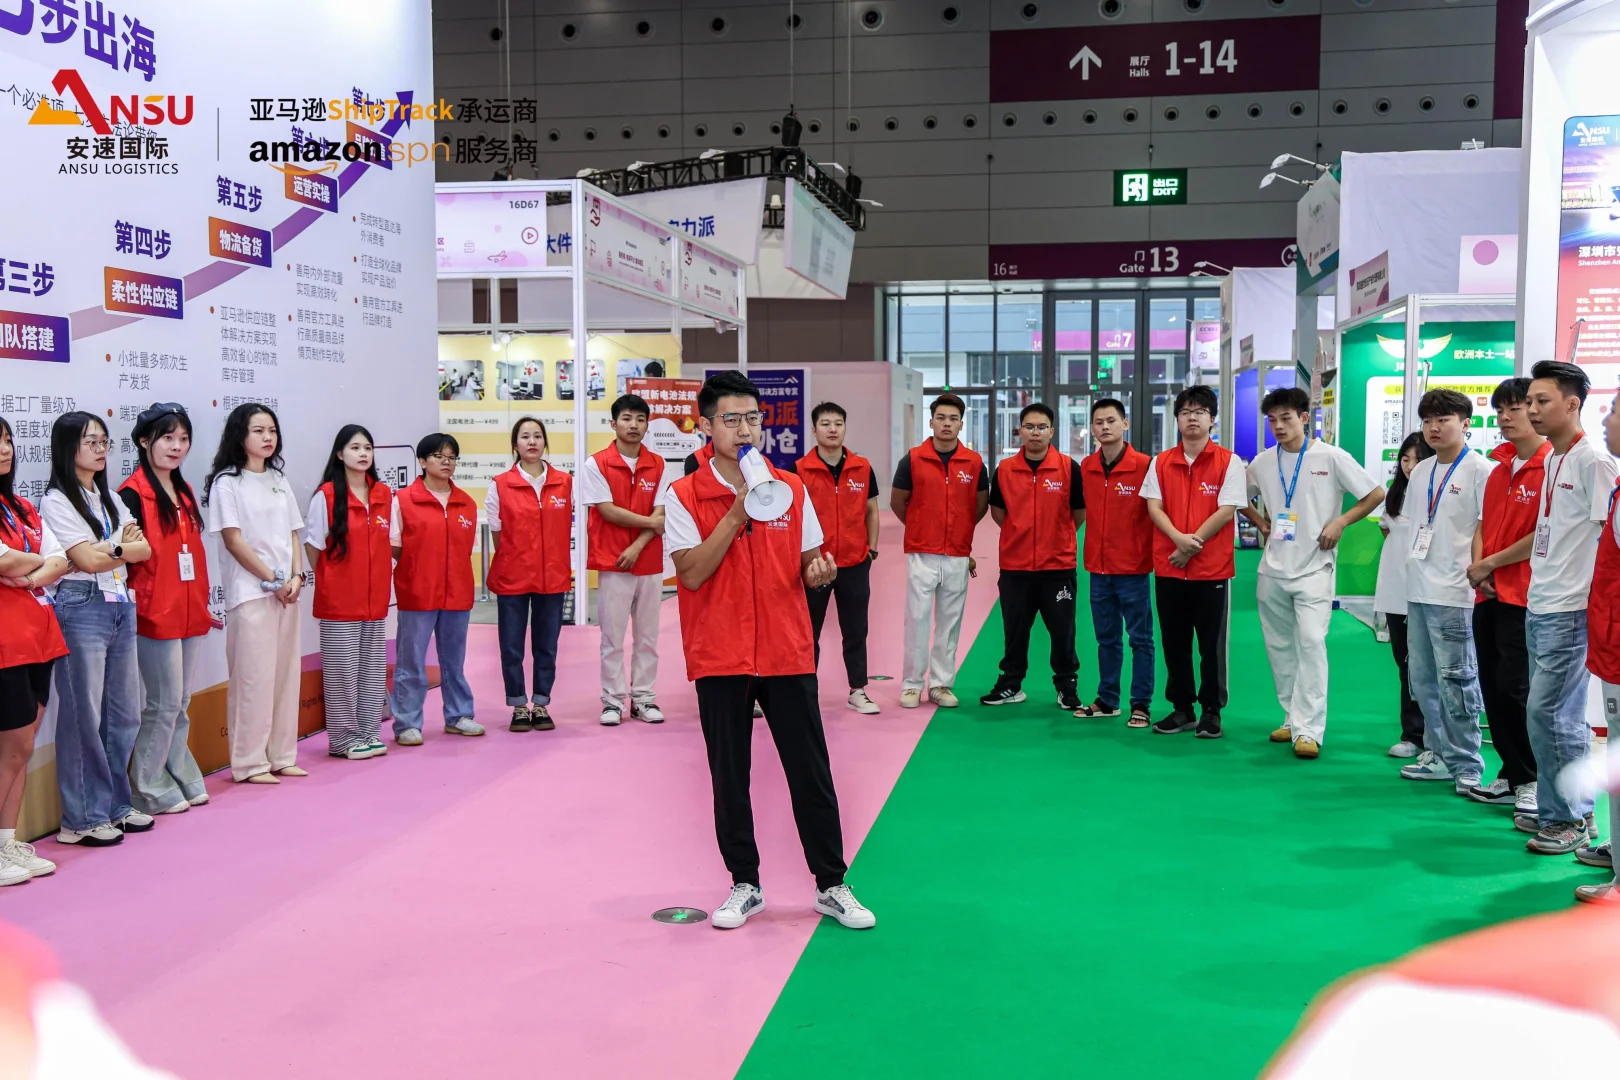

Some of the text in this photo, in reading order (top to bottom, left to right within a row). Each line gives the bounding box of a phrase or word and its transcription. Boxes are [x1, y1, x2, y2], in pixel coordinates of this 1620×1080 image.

[1165, 39, 1238, 75] 1-14
[1129, 67, 1150, 77] Halls
[216, 174, 263, 213] 第五步
[1152, 178, 1178, 187] 出口
[1152, 187, 1178, 196] EXIT
[509, 200, 540, 209] 16D67
[667, 215, 715, 238] 力派
[114, 219, 171, 260] 第四步
[219, 229, 263, 258] 物流备货
[994, 262, 1007, 276] 16
[1119, 263, 1145, 273] Gate
[1150, 246, 1180, 273] 13
[0, 257, 55, 297] 三步
[111, 278, 178, 311] 柔性供应链
[0, 322, 55, 352] 队搭建
[1122, 332, 1132, 348] 7
[118, 349, 188, 371] 小批量多频次生
[119, 372, 150, 391] 产发货
